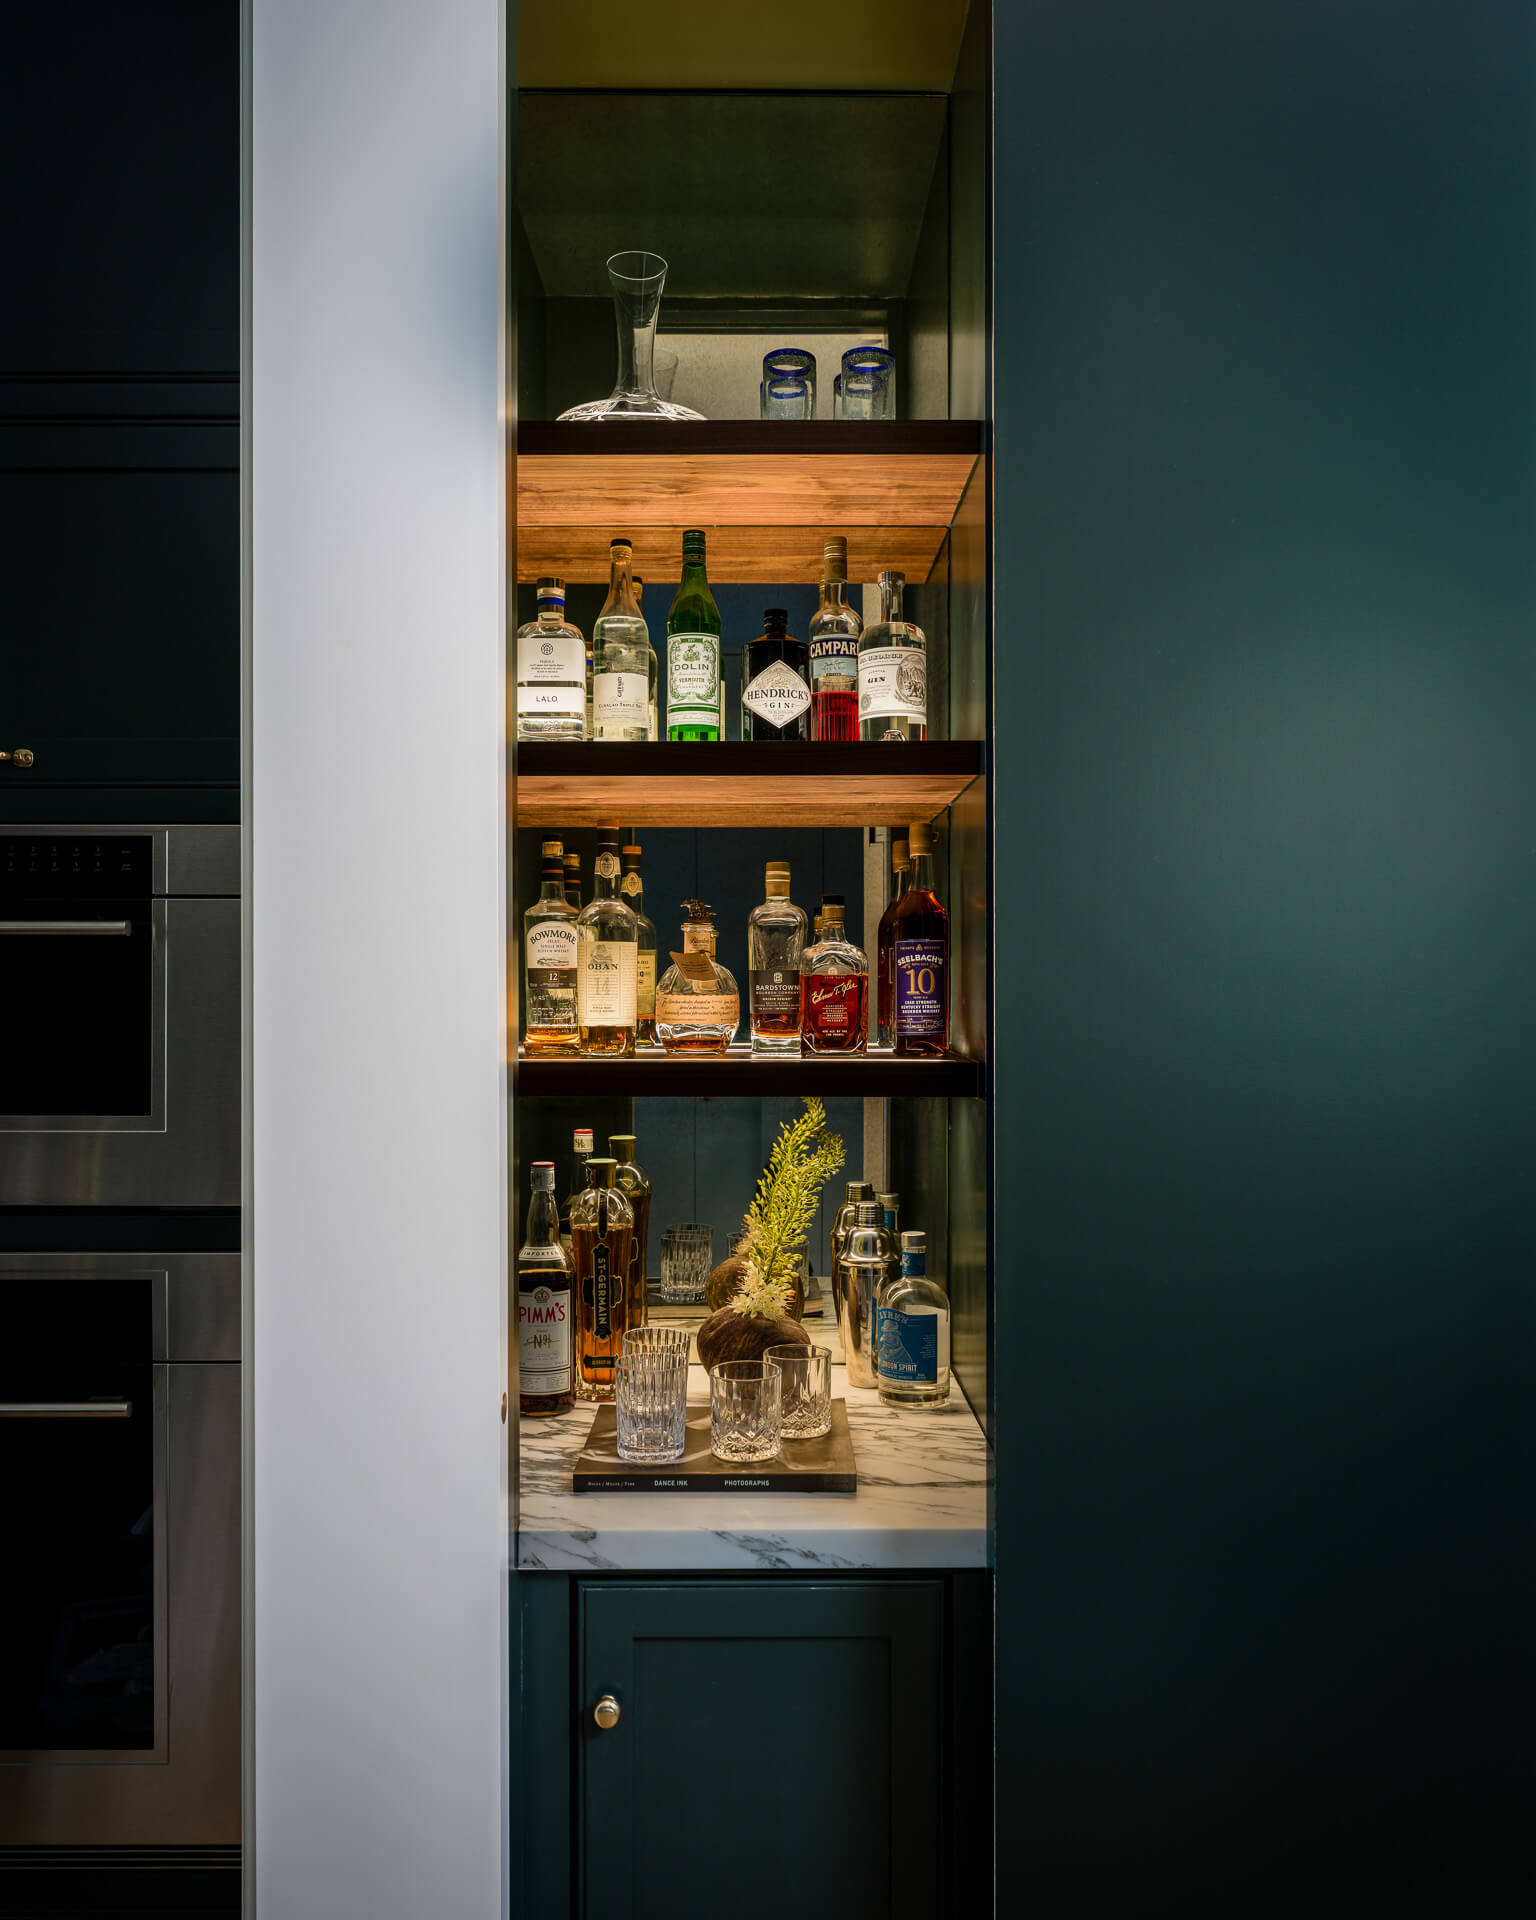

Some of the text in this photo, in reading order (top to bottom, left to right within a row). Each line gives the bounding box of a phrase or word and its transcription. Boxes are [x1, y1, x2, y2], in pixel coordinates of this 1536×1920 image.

[674, 663, 709, 671] DOLIN
[867, 676, 886, 684] GIN
[536, 695, 558, 703] LALO
[747, 688, 809, 701] HENDRICK'S
[769, 701, 791, 709] GIN
[530, 929, 577, 945] BOWMORE
[897, 954, 944, 966] SEELBACH'S
[588, 963, 618, 971] OBAN
[548, 972, 559, 982] 12
[905, 968, 935, 996] 10
[597, 1257, 608, 1326] ST-GERMAIN
[519, 1301, 566, 1324] PIMM'S
[653, 1479, 689, 1487] DANCE INK
[724, 1479, 770, 1487] PHOTOGRAPHS
